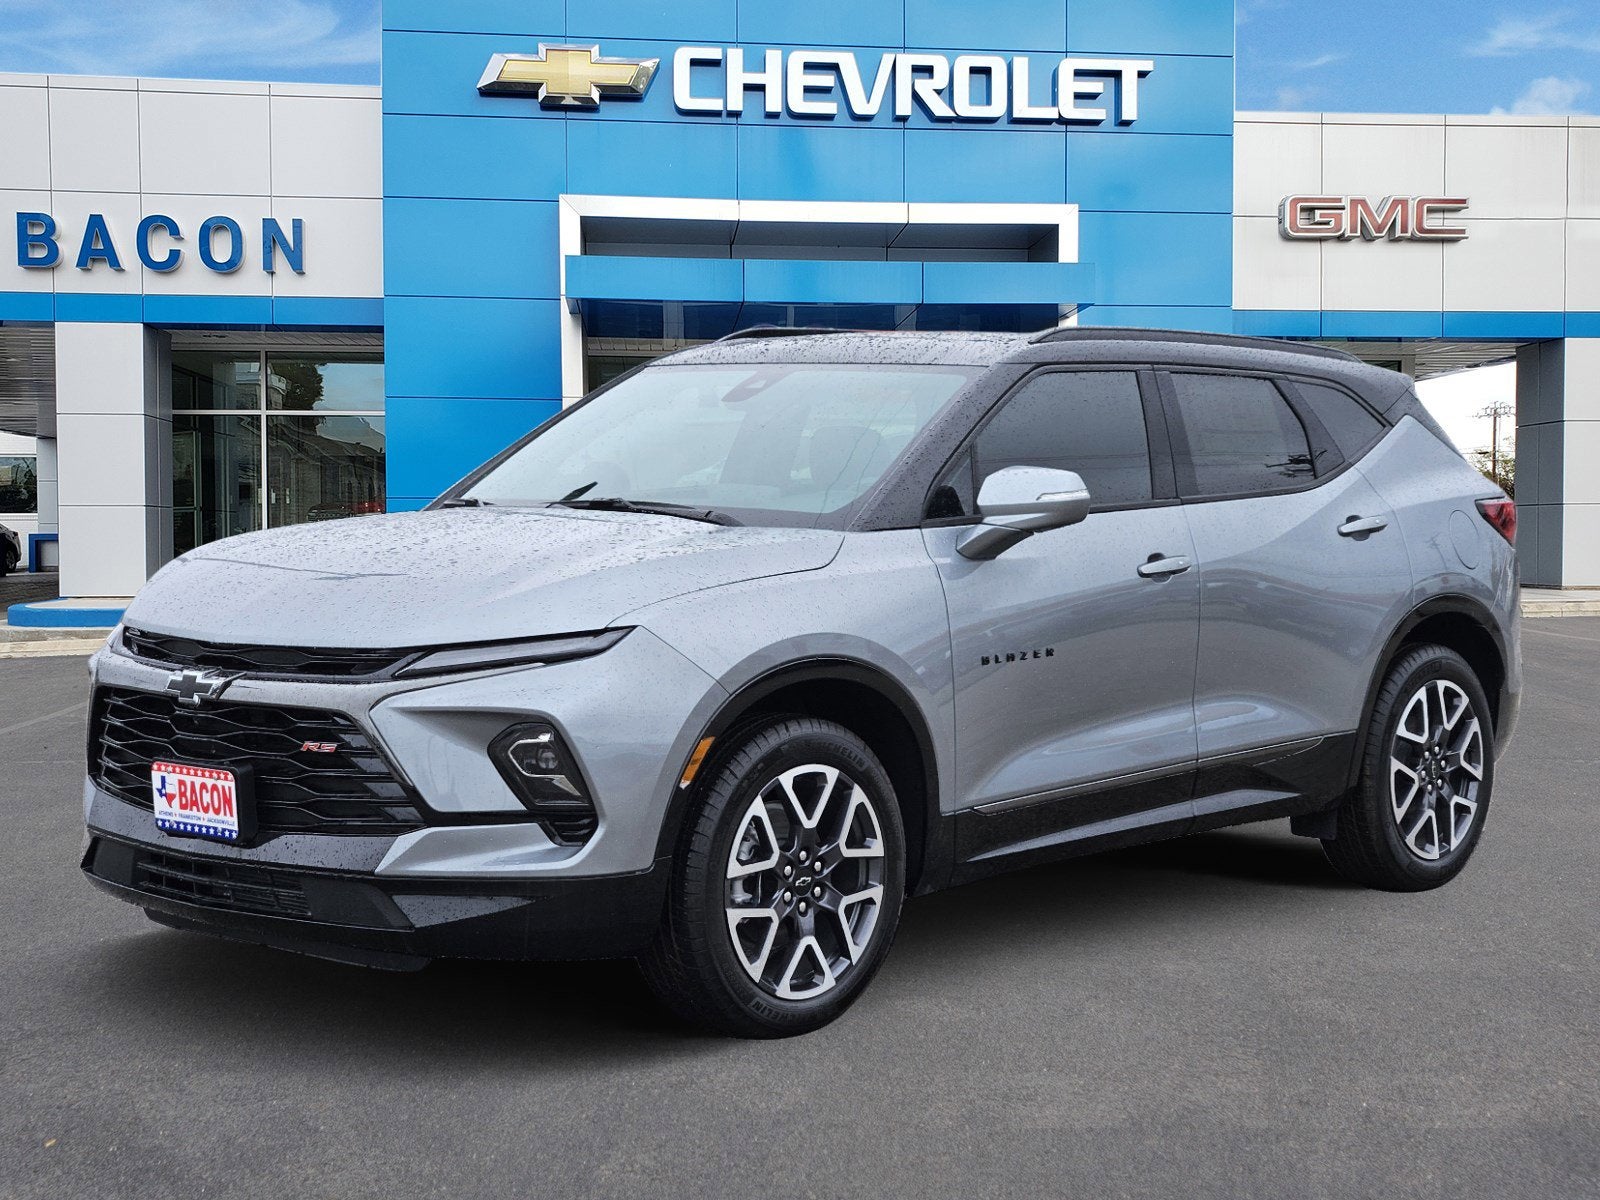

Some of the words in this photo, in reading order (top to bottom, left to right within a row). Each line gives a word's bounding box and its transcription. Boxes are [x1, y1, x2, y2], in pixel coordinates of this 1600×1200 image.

[673, 46, 1154, 126] CHEVROLET
[1278, 195, 1469, 240] GMC
[16, 211, 306, 275] BACON
[981, 647, 1055, 666] BLAZER
[300, 741, 338, 752] RS
[177, 779, 234, 818] BACON
